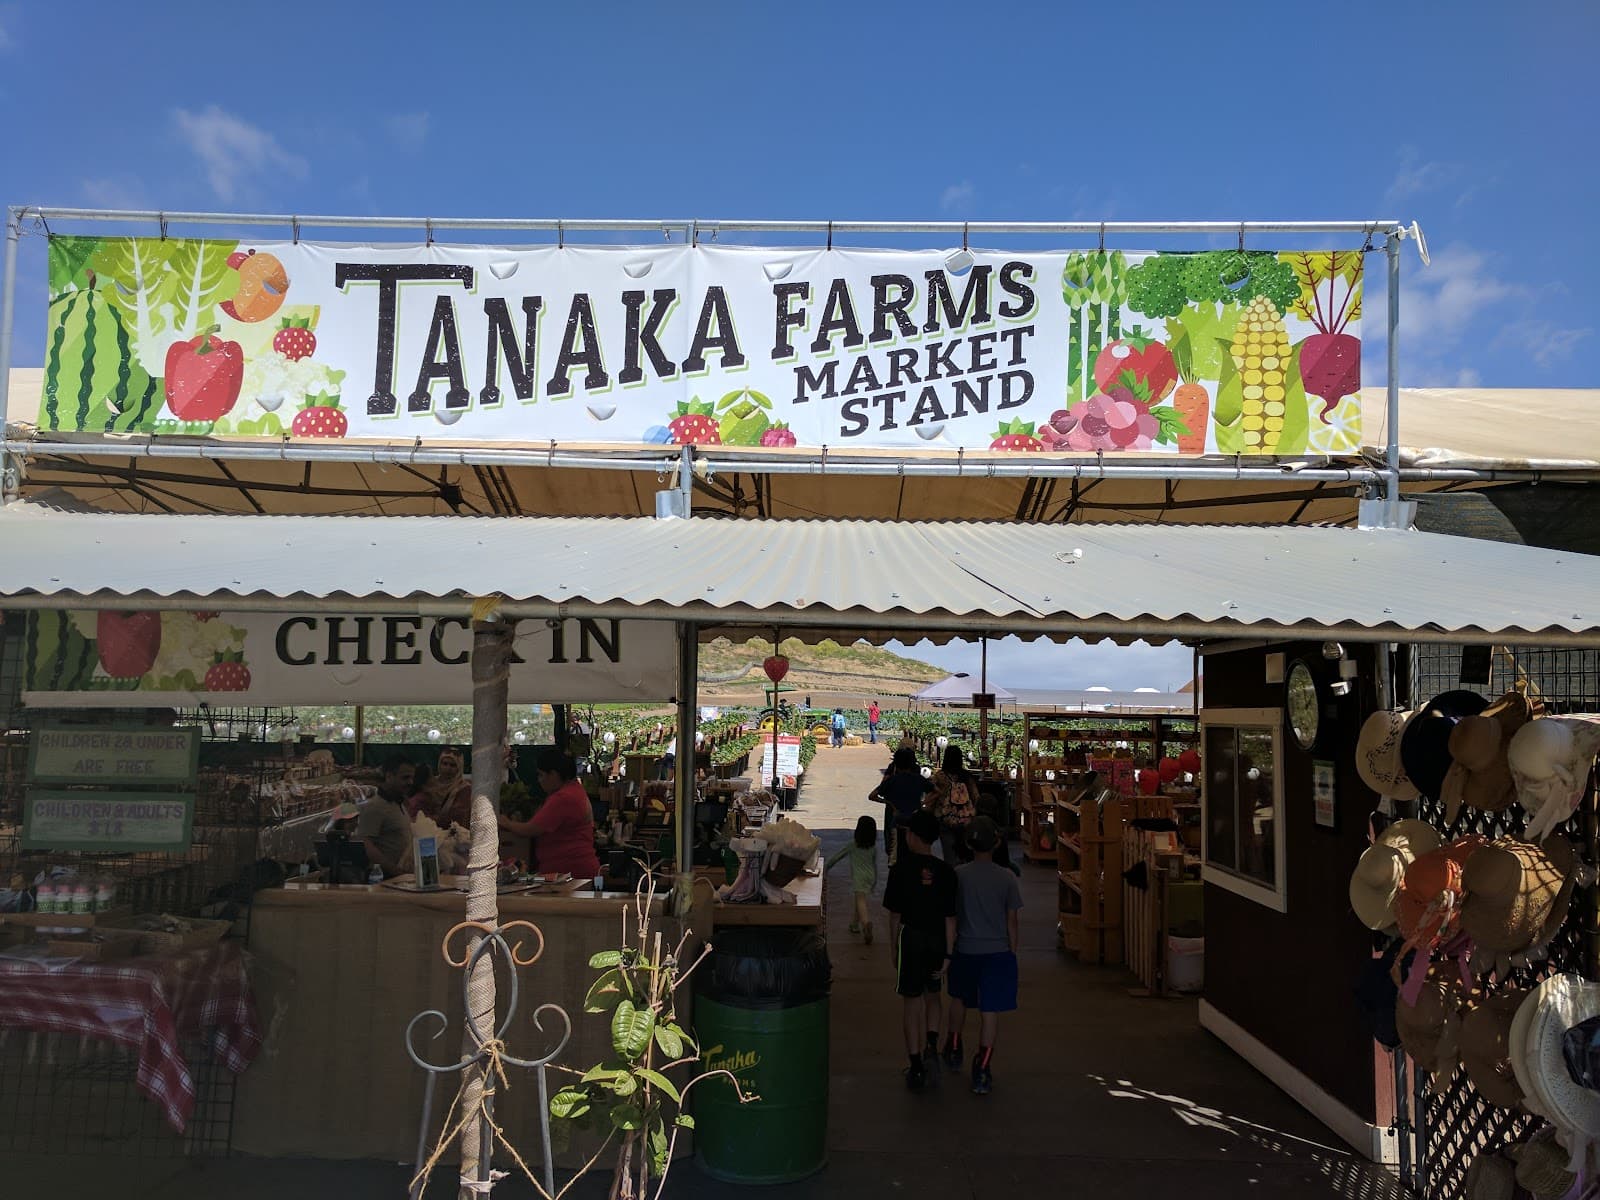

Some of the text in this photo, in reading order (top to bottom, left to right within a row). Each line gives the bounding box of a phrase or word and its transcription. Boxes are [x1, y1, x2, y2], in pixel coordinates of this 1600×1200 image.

[335, 261, 1039, 418] TANAKA FARMS
[792, 325, 1035, 404] MARKET
[840, 369, 1035, 437] STAND
[548, 617, 622, 663] IN
[41, 735, 110, 749] CHILDREN
[137, 735, 187, 750] UNDER
[72, 759, 155, 774] ARE FREE
[35, 801, 110, 819] CHILDREN
[127, 803, 184, 819] ADULTS
